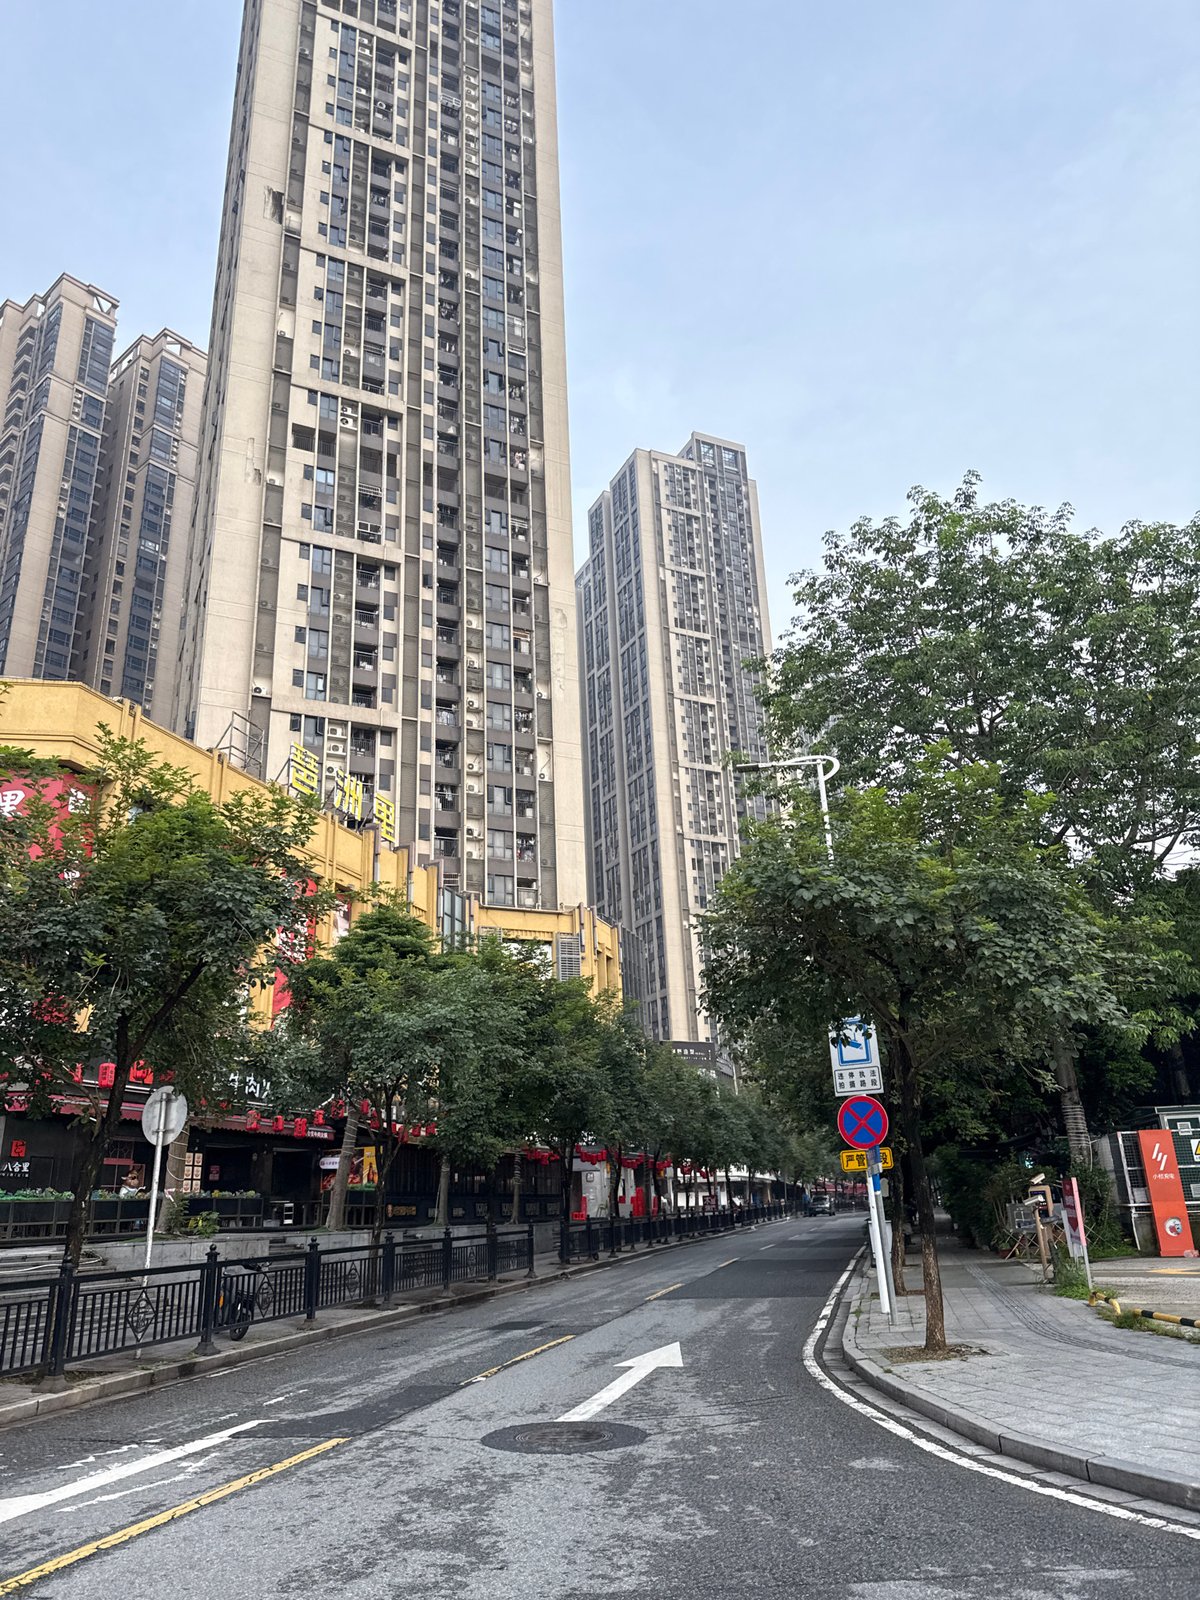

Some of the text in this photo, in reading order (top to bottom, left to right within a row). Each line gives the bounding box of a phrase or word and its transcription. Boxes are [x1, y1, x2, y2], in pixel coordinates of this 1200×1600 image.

[845, 1152, 889, 1167] 严管段
[3, 1161, 30, 1172] 八合里
